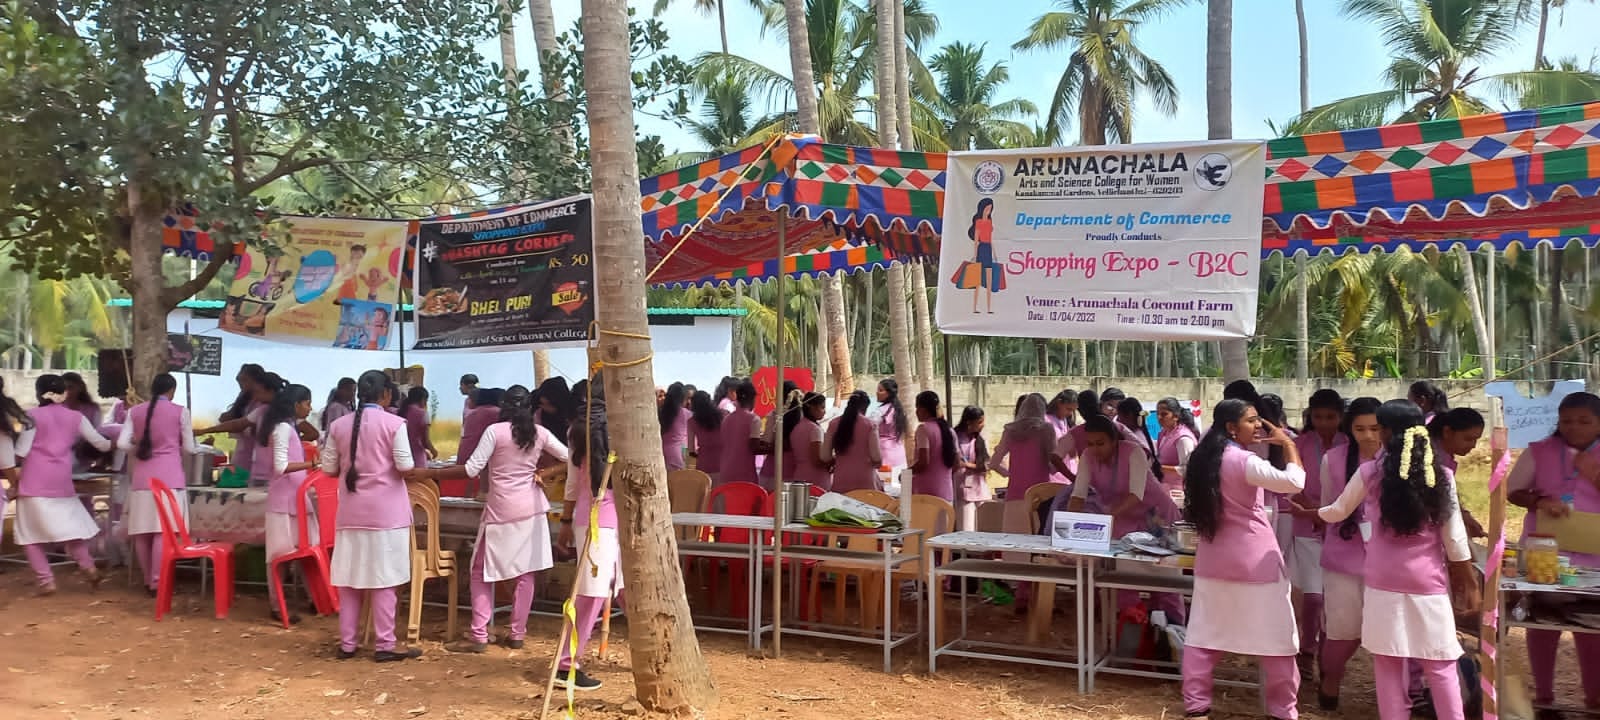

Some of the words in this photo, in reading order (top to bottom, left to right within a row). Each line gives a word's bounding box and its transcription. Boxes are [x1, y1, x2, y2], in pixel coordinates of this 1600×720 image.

[1013, 152, 1188, 176] ARUNACHALA
[1019, 177, 1038, 188] Arts
[1040, 177, 1055, 188] and
[1058, 176, 1092, 188] Science
[1094, 175, 1127, 189] College
[1129, 174, 1143, 186] for
[1146, 174, 1180, 185] Women
[441, 218, 505, 234] DEPARTMENT
[507, 215, 521, 227] OF
[523, 203, 577, 224] COMMERCE
[1015, 212, 1113, 229] Department
[1116, 212, 1136, 231] of
[1139, 211, 1232, 225] Commerce
[472, 226, 520, 241] SHOPPING
[1086, 232, 1119, 243] Proudly
[1121, 232, 1162, 241] Conducts
[443, 243, 508, 260] HASHTAG
[515, 233, 575, 252] CORNER
[1006, 251, 1097, 279] Shopping
[1102, 251, 1159, 279] Expo
[1188, 251, 1249, 278] B2C
[558, 289, 579, 302] Sale
[1025, 295, 1061, 307] Venue
[1069, 296, 1139, 309] Arunachala
[1142, 298, 1194, 310] Coconut
[1198, 299, 1233, 311] Farm
[470, 300, 501, 317] BHEL
[506, 294, 533, 312] PURI
[1028, 311, 1044, 320] Date
[1050, 311, 1096, 322] 13/04/2023
[1117, 313, 1135, 324] Time
[1141, 313, 1163, 325] 10.30
[1165, 317, 1178, 325] am
[1180, 316, 1188, 325] to
[1190, 315, 1210, 326] 2:00
[1212, 318, 1225, 328] pm
